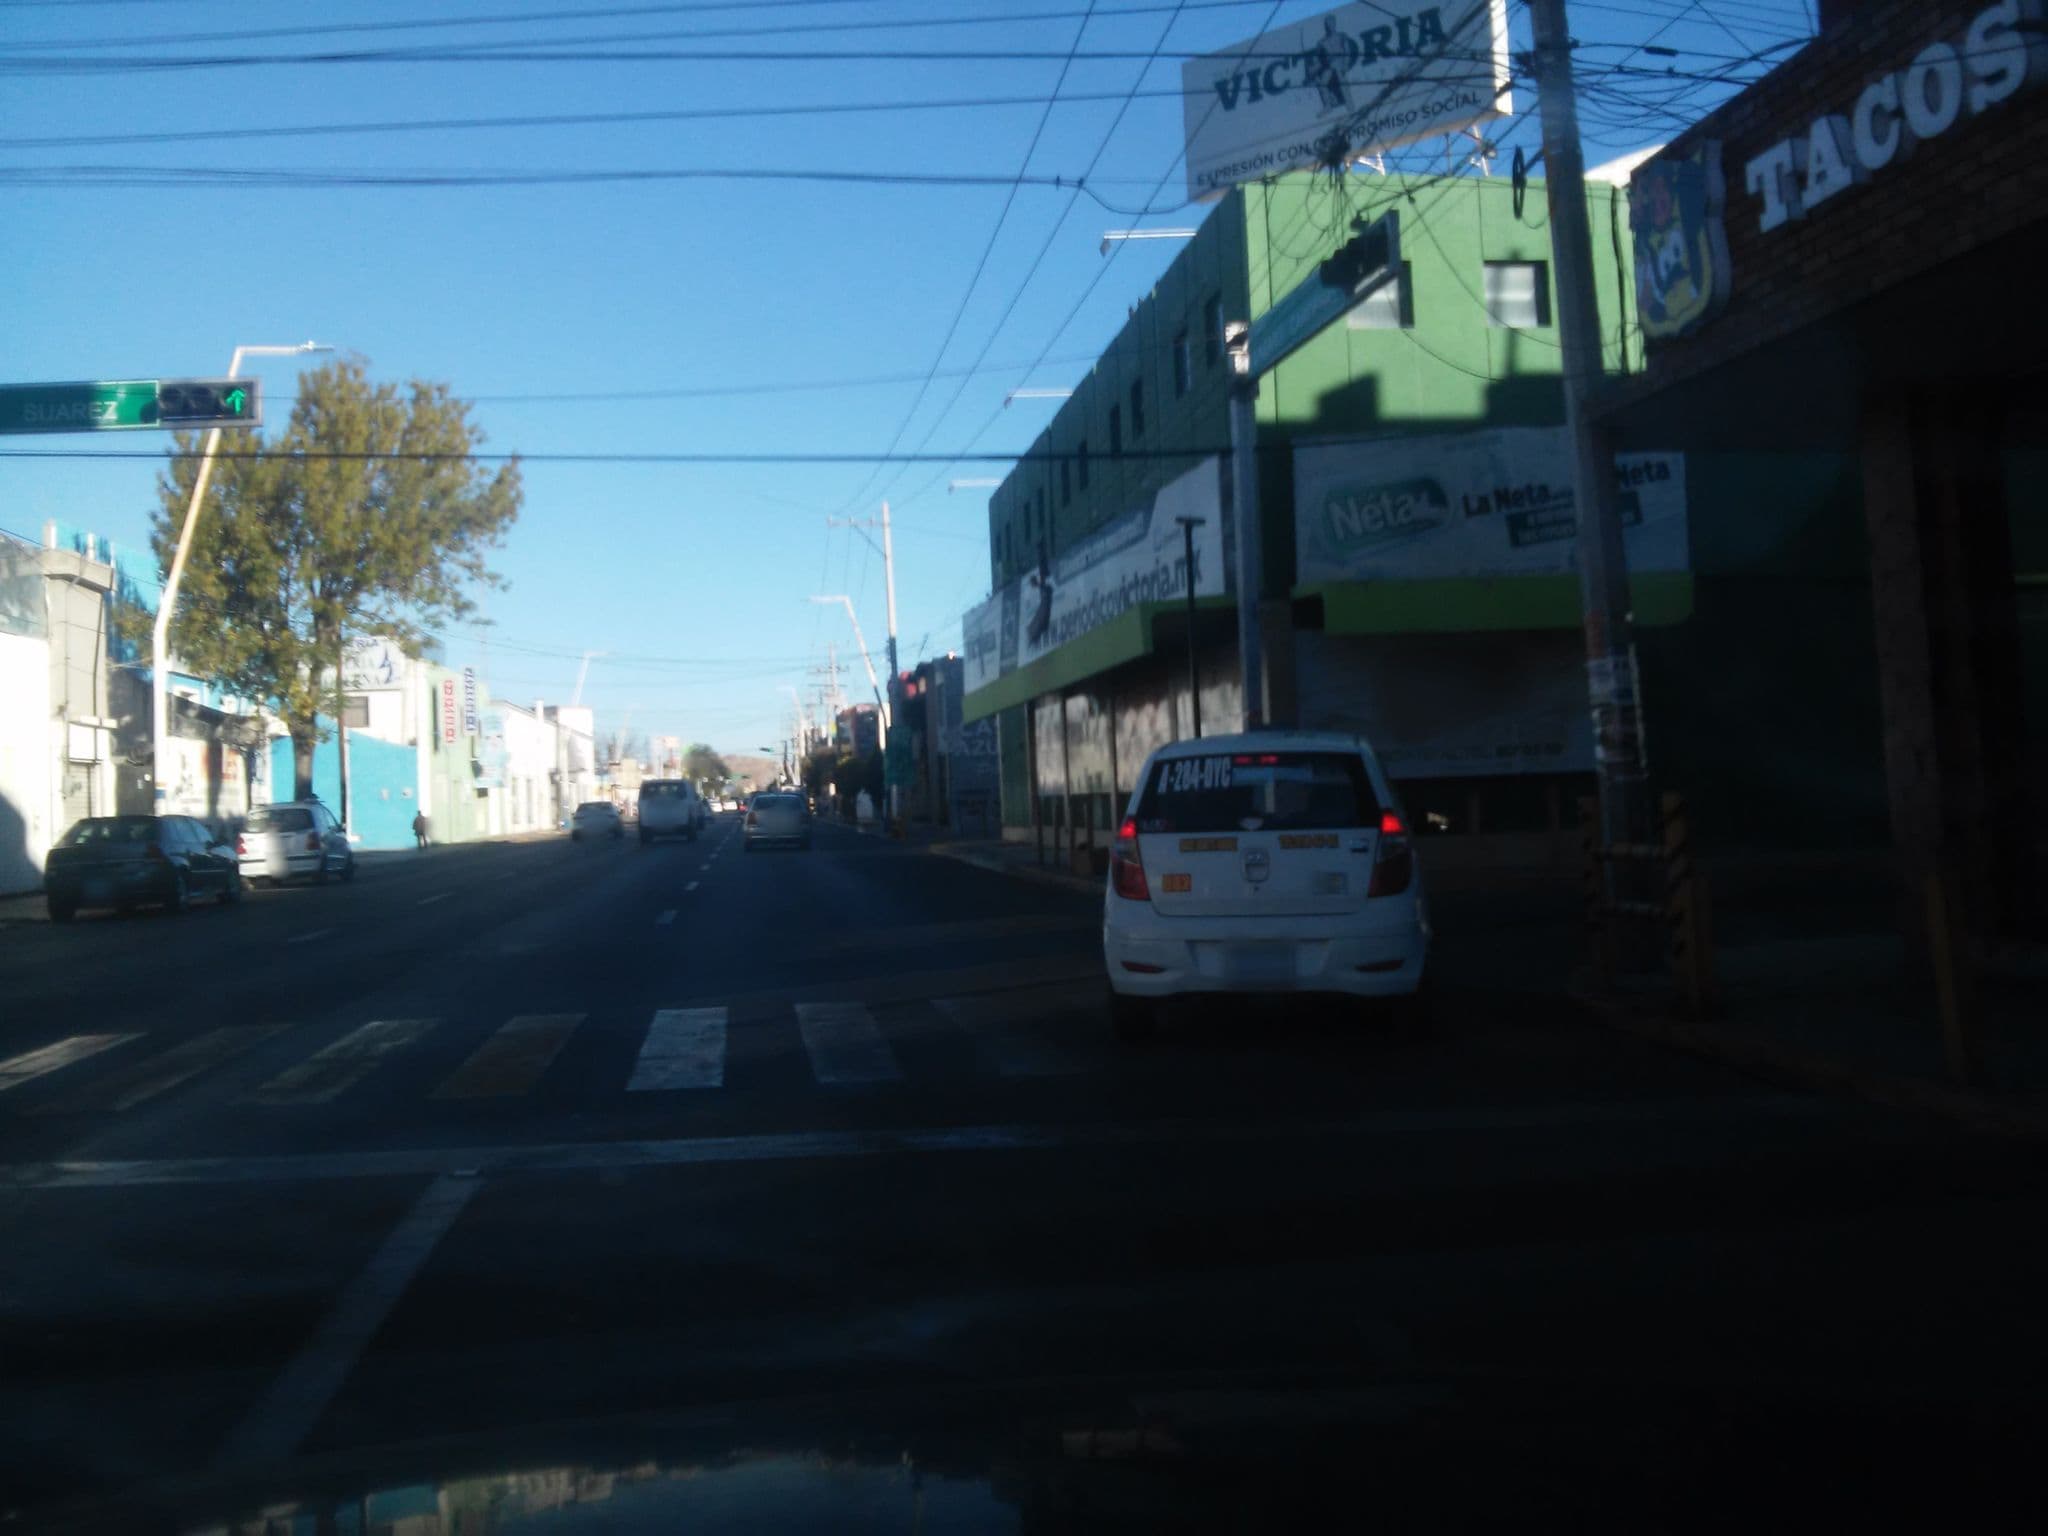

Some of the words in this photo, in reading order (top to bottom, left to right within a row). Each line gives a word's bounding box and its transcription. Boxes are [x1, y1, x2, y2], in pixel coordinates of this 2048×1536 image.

[1277, 143, 1311, 162] CON
[1421, 91, 1482, 118] SOCIAL
[1744, 2, 2028, 233] TACOS
[23, 400, 119, 423] SUAREZ
[1328, 489, 1416, 542] Neta
[1462, 493, 1491, 518] La
[1493, 483, 1552, 512] Neta
